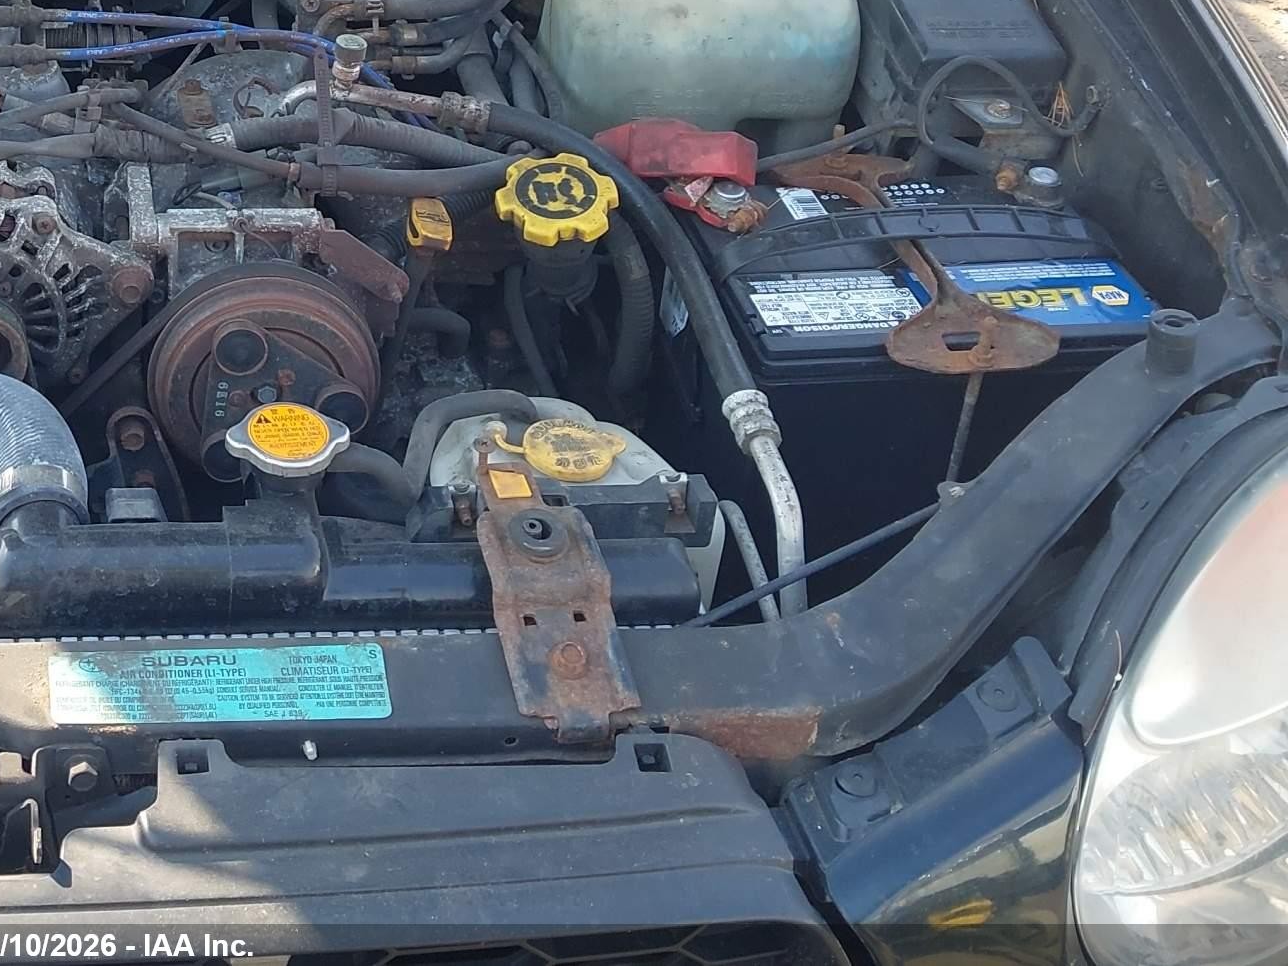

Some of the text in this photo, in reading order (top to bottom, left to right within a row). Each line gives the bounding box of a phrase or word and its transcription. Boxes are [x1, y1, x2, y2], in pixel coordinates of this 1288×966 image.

[1096, 290, 1123, 300] NAPA
[793, 321, 892, 332] DANGER/POISON
[288, 653, 337, 665] TOKYO JAPAN
[368, 649, 378, 659] S
[141, 654, 237, 667] SUBARU
[138, 668, 202, 679] CONDITIONER
[204, 667, 247, 679] (LI-TYPE)
[280, 665, 339, 677] CLIMATISEUR
